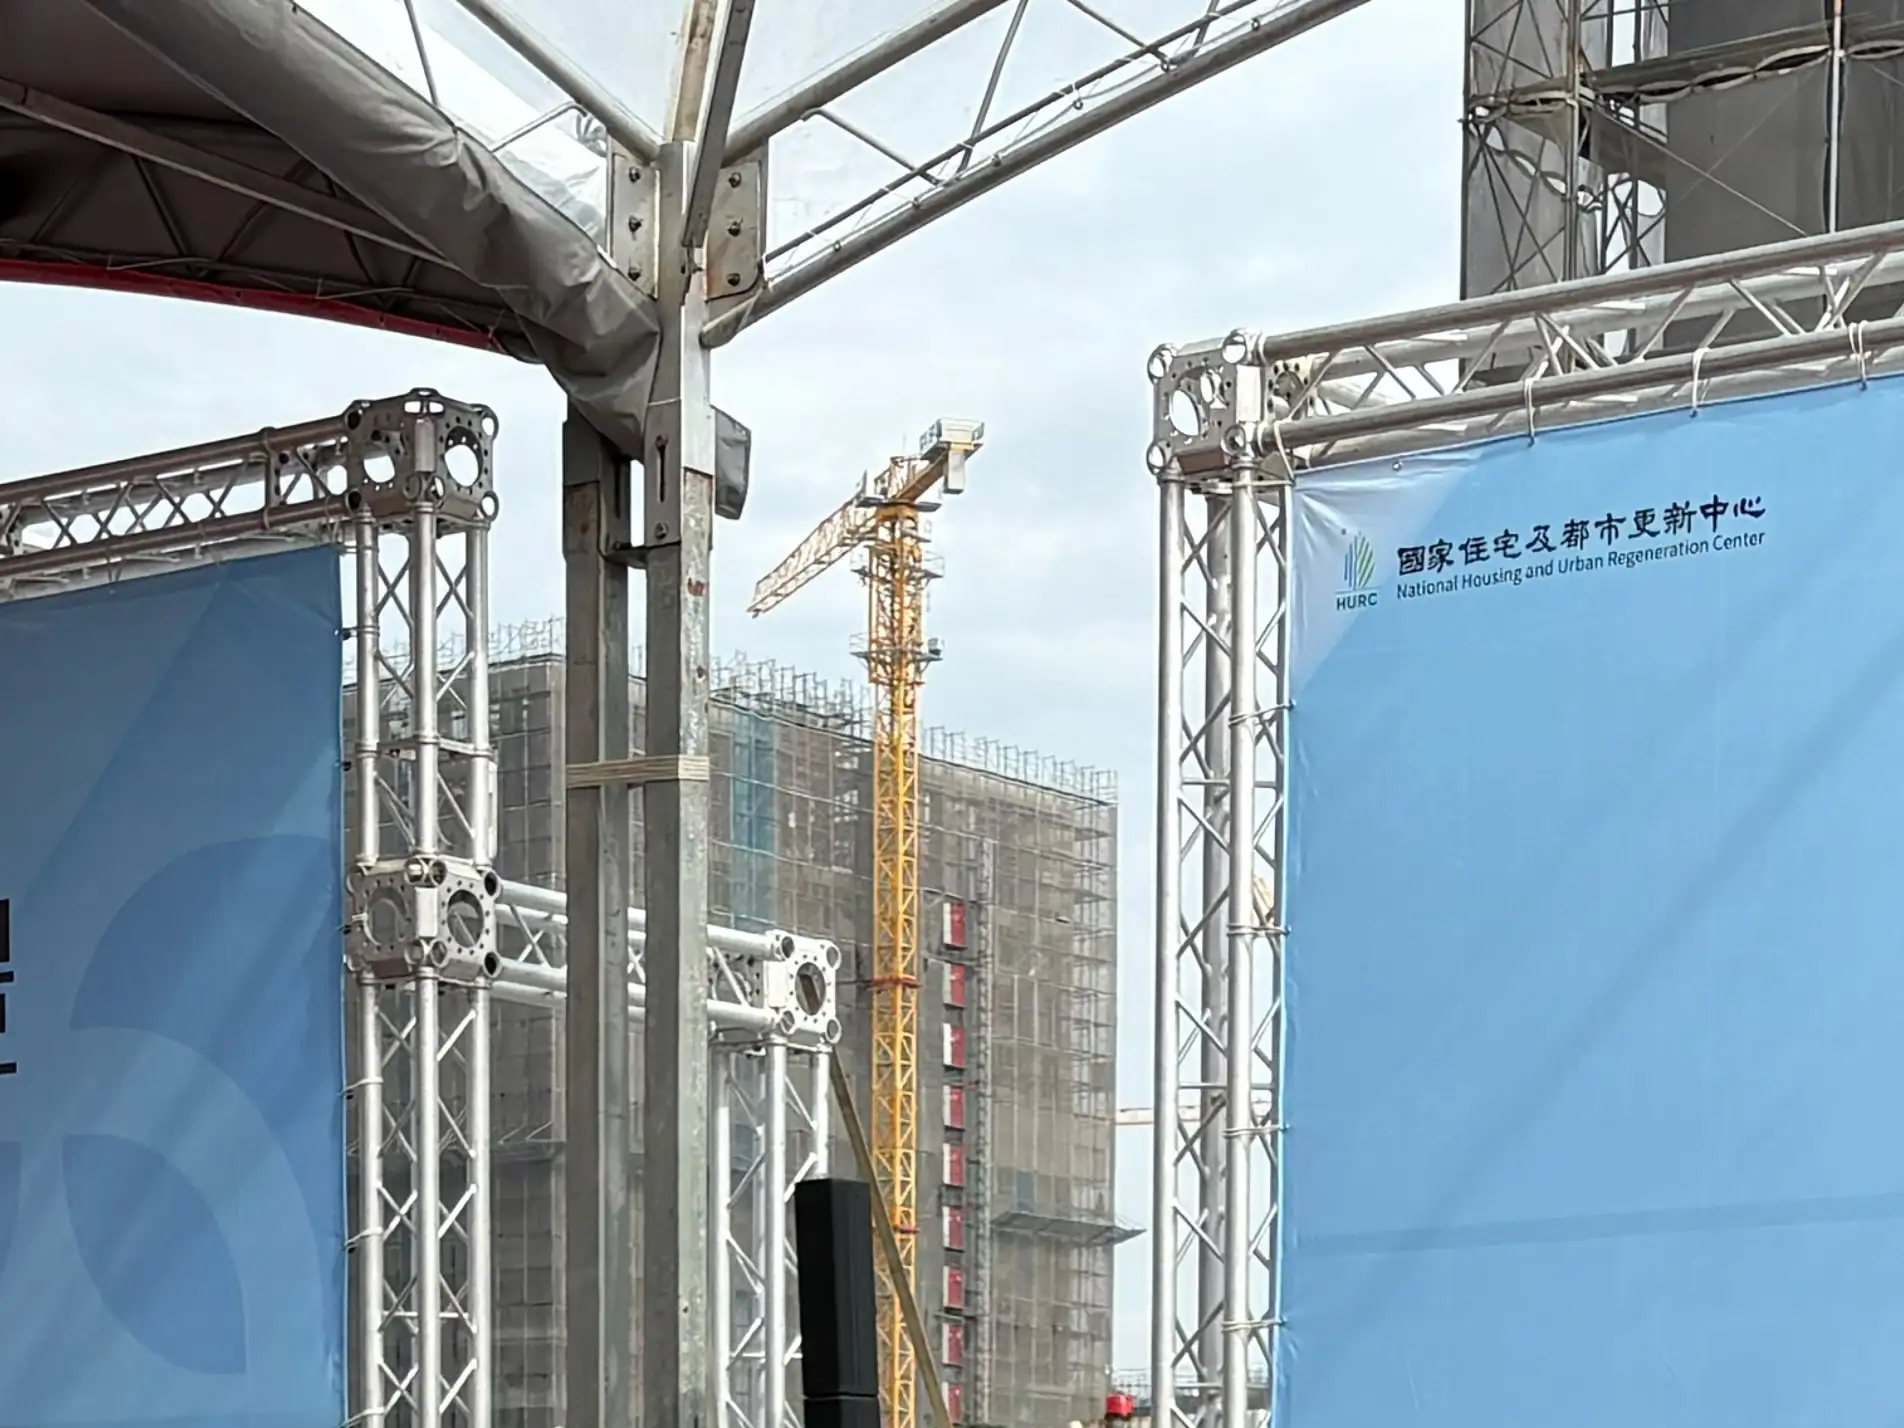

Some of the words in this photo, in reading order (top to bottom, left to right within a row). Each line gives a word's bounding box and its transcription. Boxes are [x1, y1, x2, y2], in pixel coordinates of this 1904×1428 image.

[1396, 494, 1767, 577] 國家住宅及都市更新中心
[1396, 575, 1459, 600] National
[1461, 565, 1523, 588] Housing
[1525, 559, 1554, 579] and
[1557, 554, 1604, 575] Urban
[1607, 538, 1710, 568] Regeneration
[1712, 530, 1766, 552] Center
[1335, 592, 1378, 612] HURC
